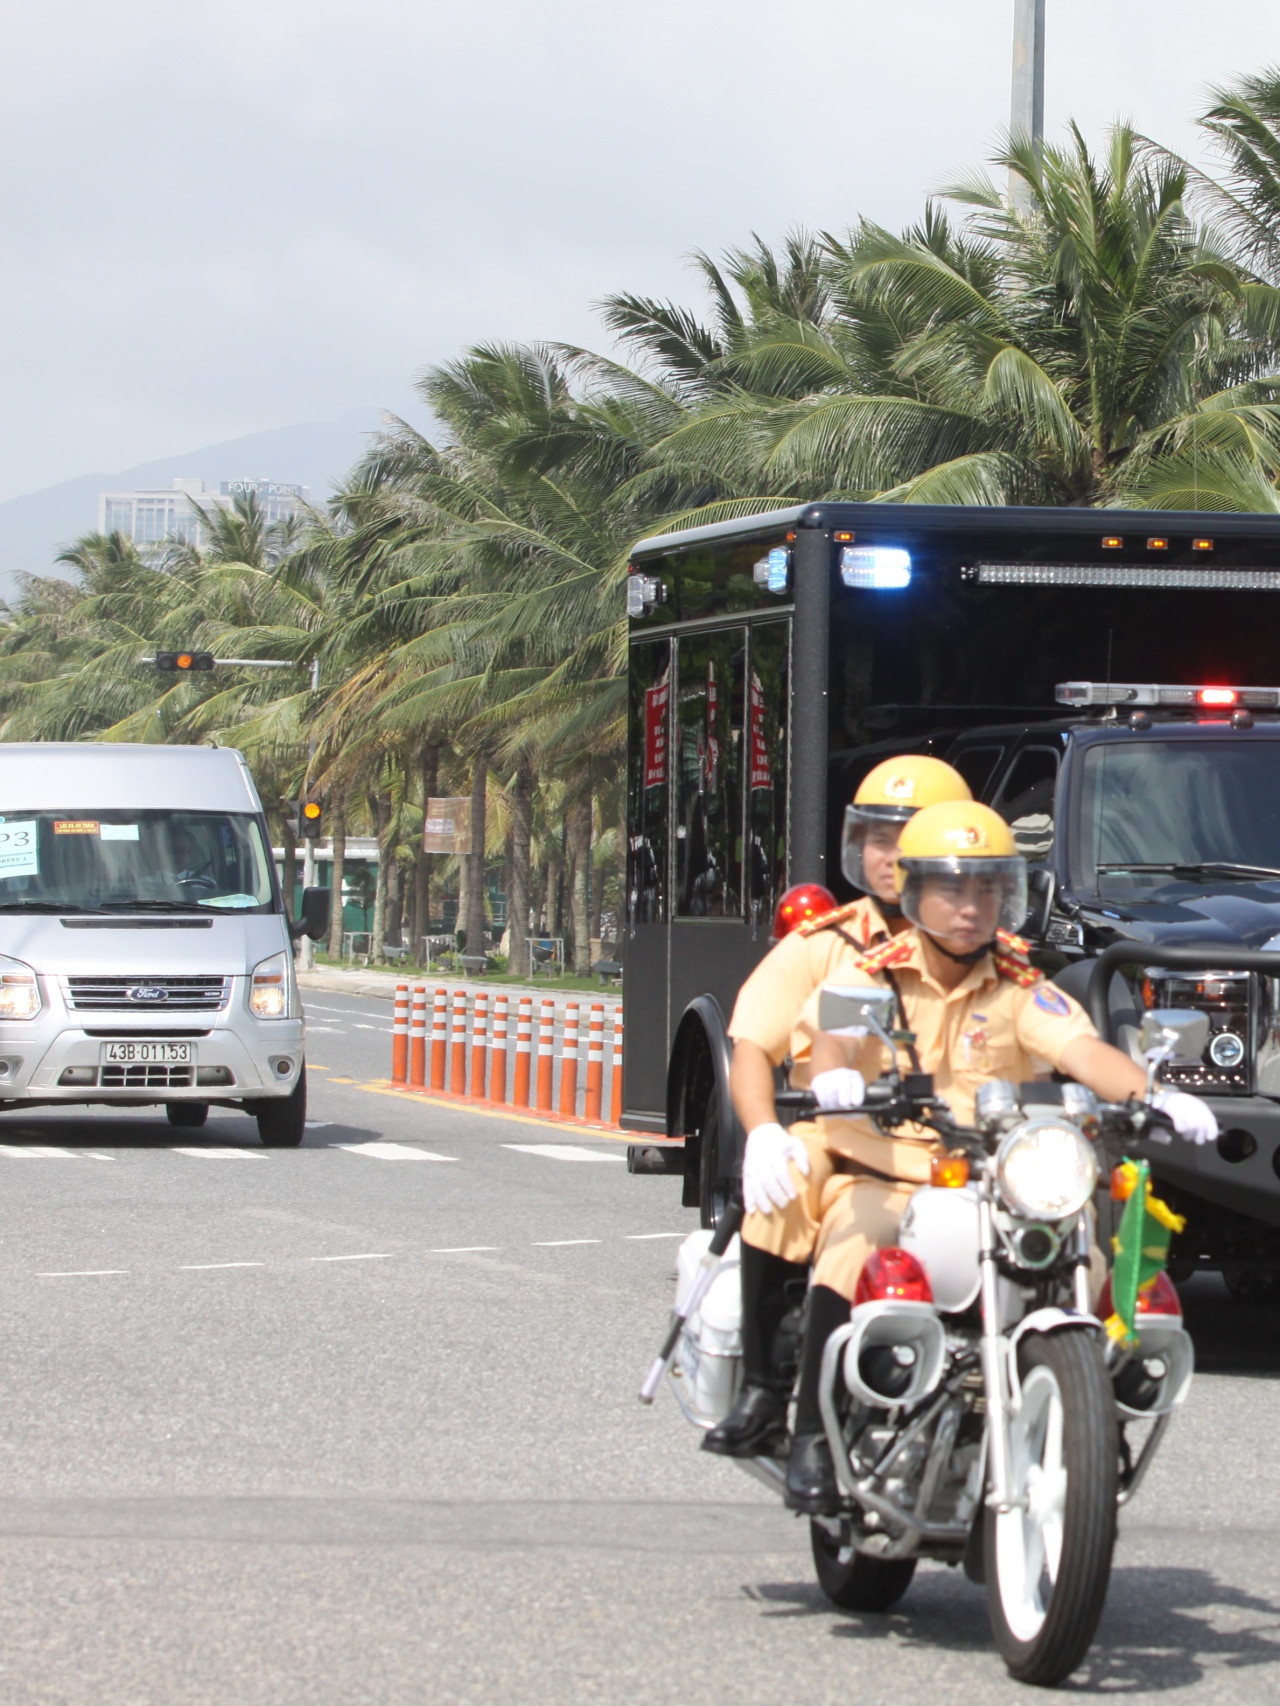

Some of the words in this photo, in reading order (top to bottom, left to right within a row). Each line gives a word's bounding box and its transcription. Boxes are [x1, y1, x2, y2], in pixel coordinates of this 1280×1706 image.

[227, 482, 258, 493] FOUR
[137, 988, 159, 998] Ford
[109, 1044, 188, 1060] 43B-011.53
